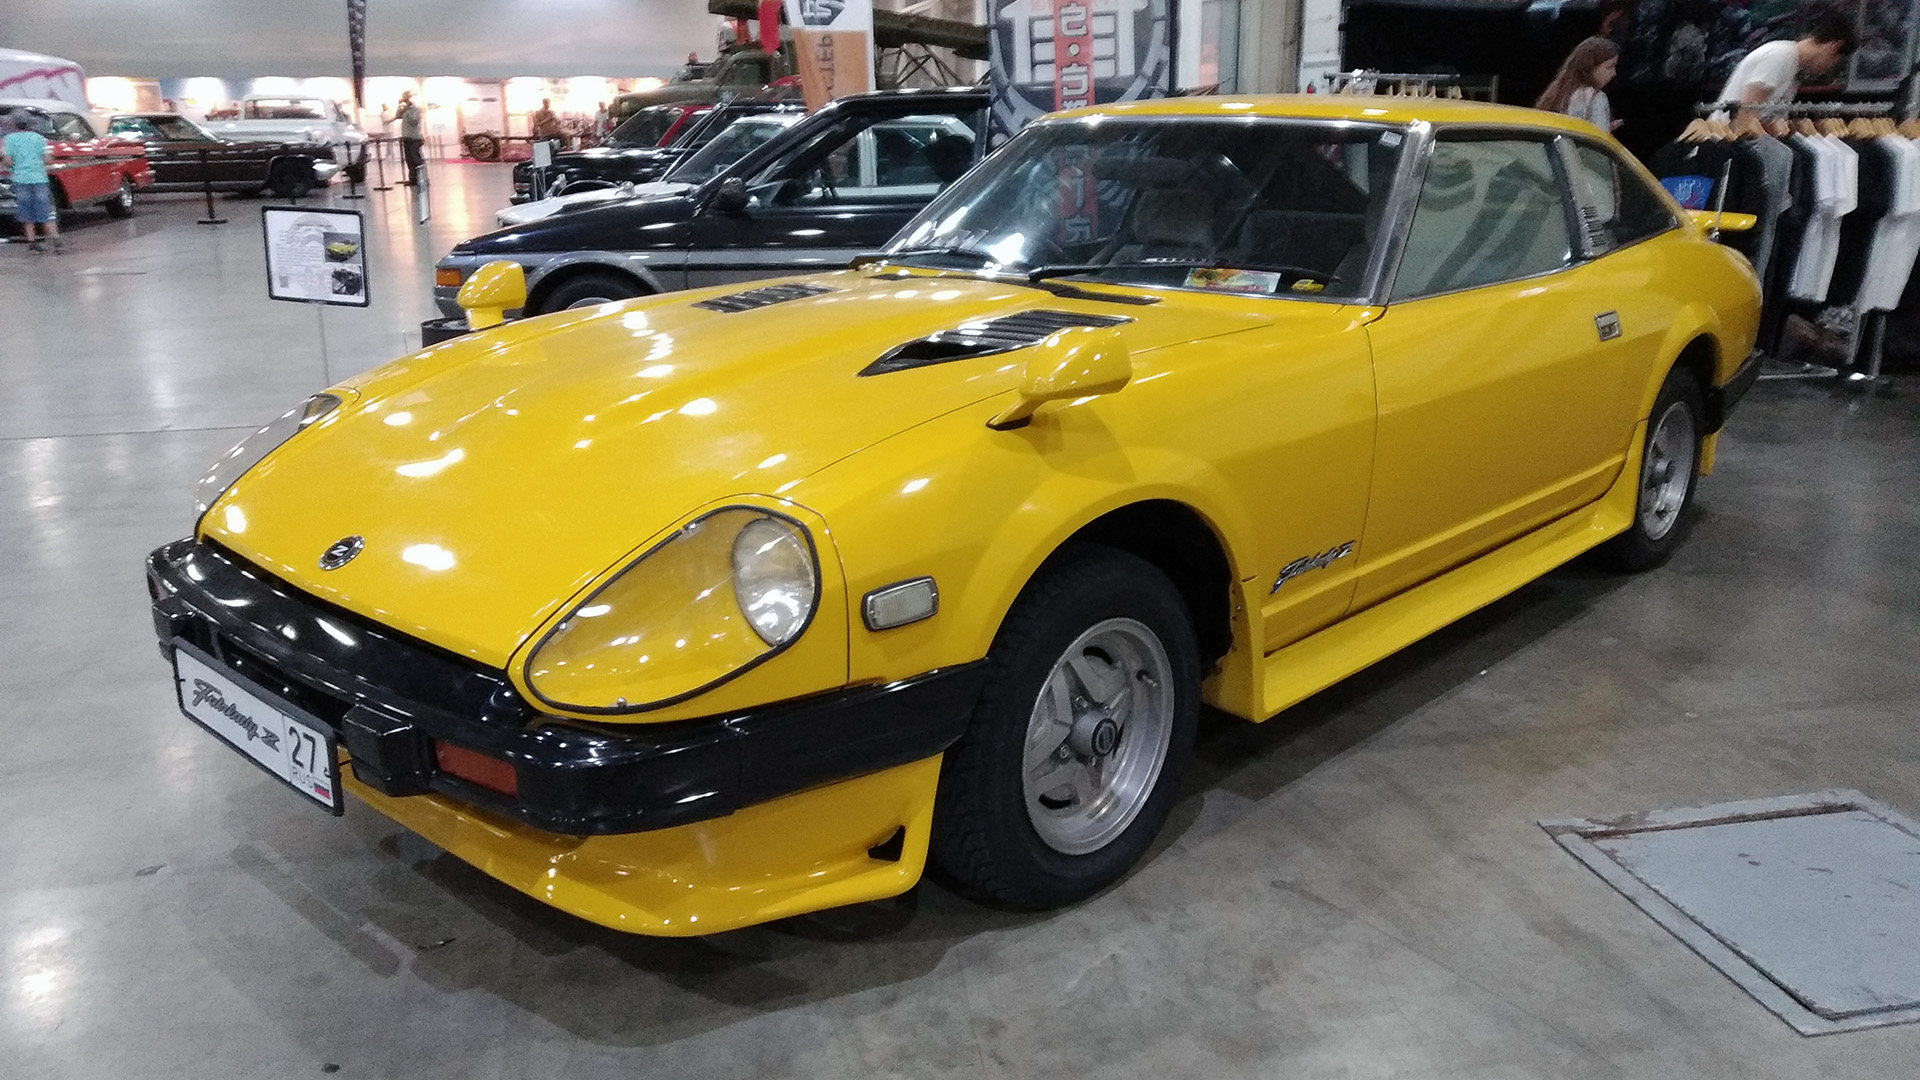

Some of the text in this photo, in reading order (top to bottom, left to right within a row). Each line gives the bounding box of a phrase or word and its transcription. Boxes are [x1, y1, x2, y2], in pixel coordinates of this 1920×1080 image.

[192, 678, 280, 753] Fairlady Z
[288, 726, 317, 774] 27
[291, 765, 314, 789] RUS
